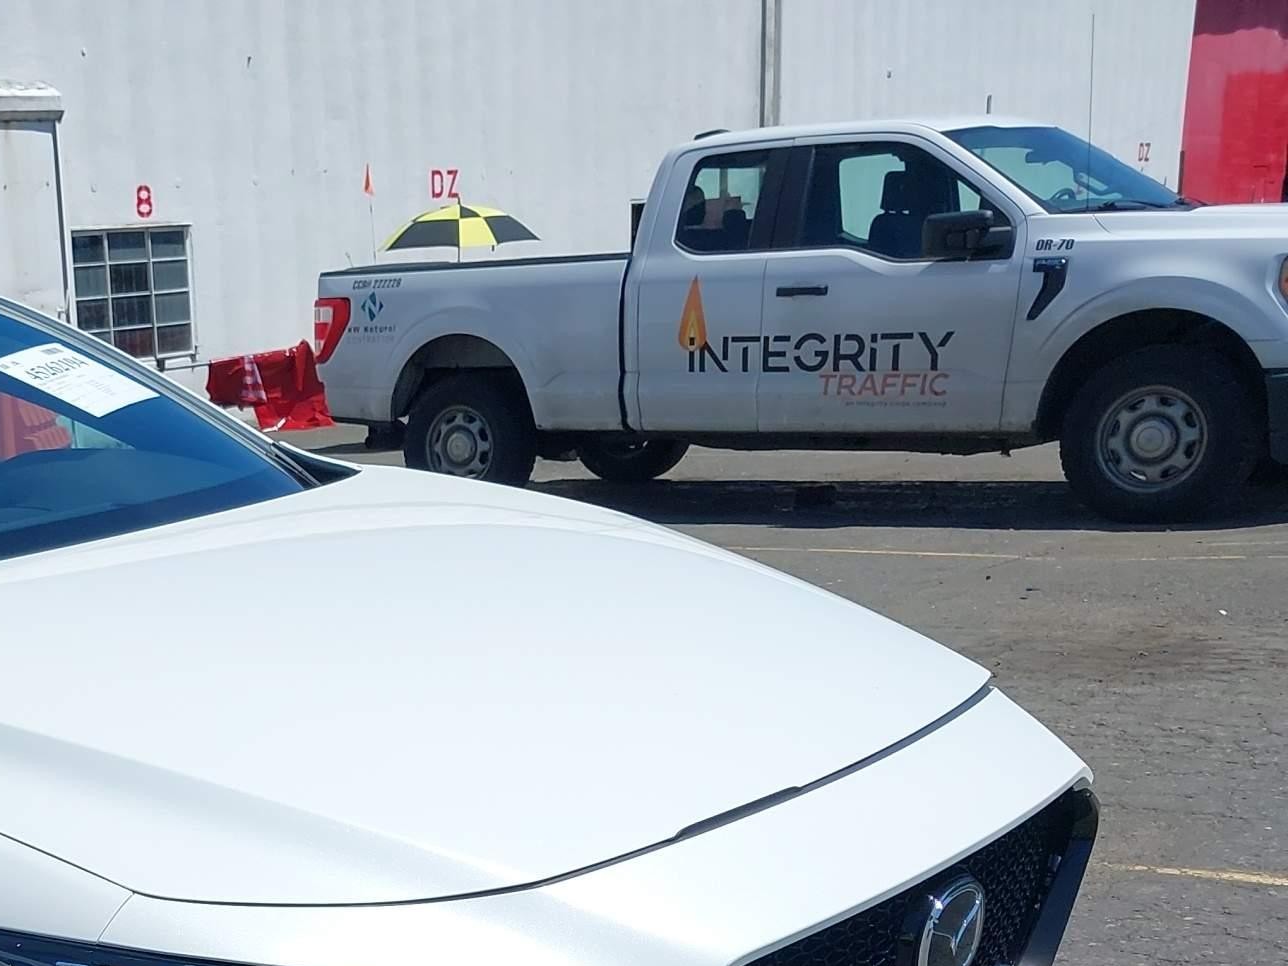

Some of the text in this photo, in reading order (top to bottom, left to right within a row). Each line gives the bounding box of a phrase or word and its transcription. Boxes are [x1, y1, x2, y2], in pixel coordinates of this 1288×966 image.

[431, 170, 459, 199] DZ
[136, 185, 153, 218] 8
[1036, 238, 1075, 251] OR-70
[687, 331, 955, 372] INTEGRITY
[24, 356, 89, 380] 45262194
[819, 374, 950, 396] TRAFFIC
